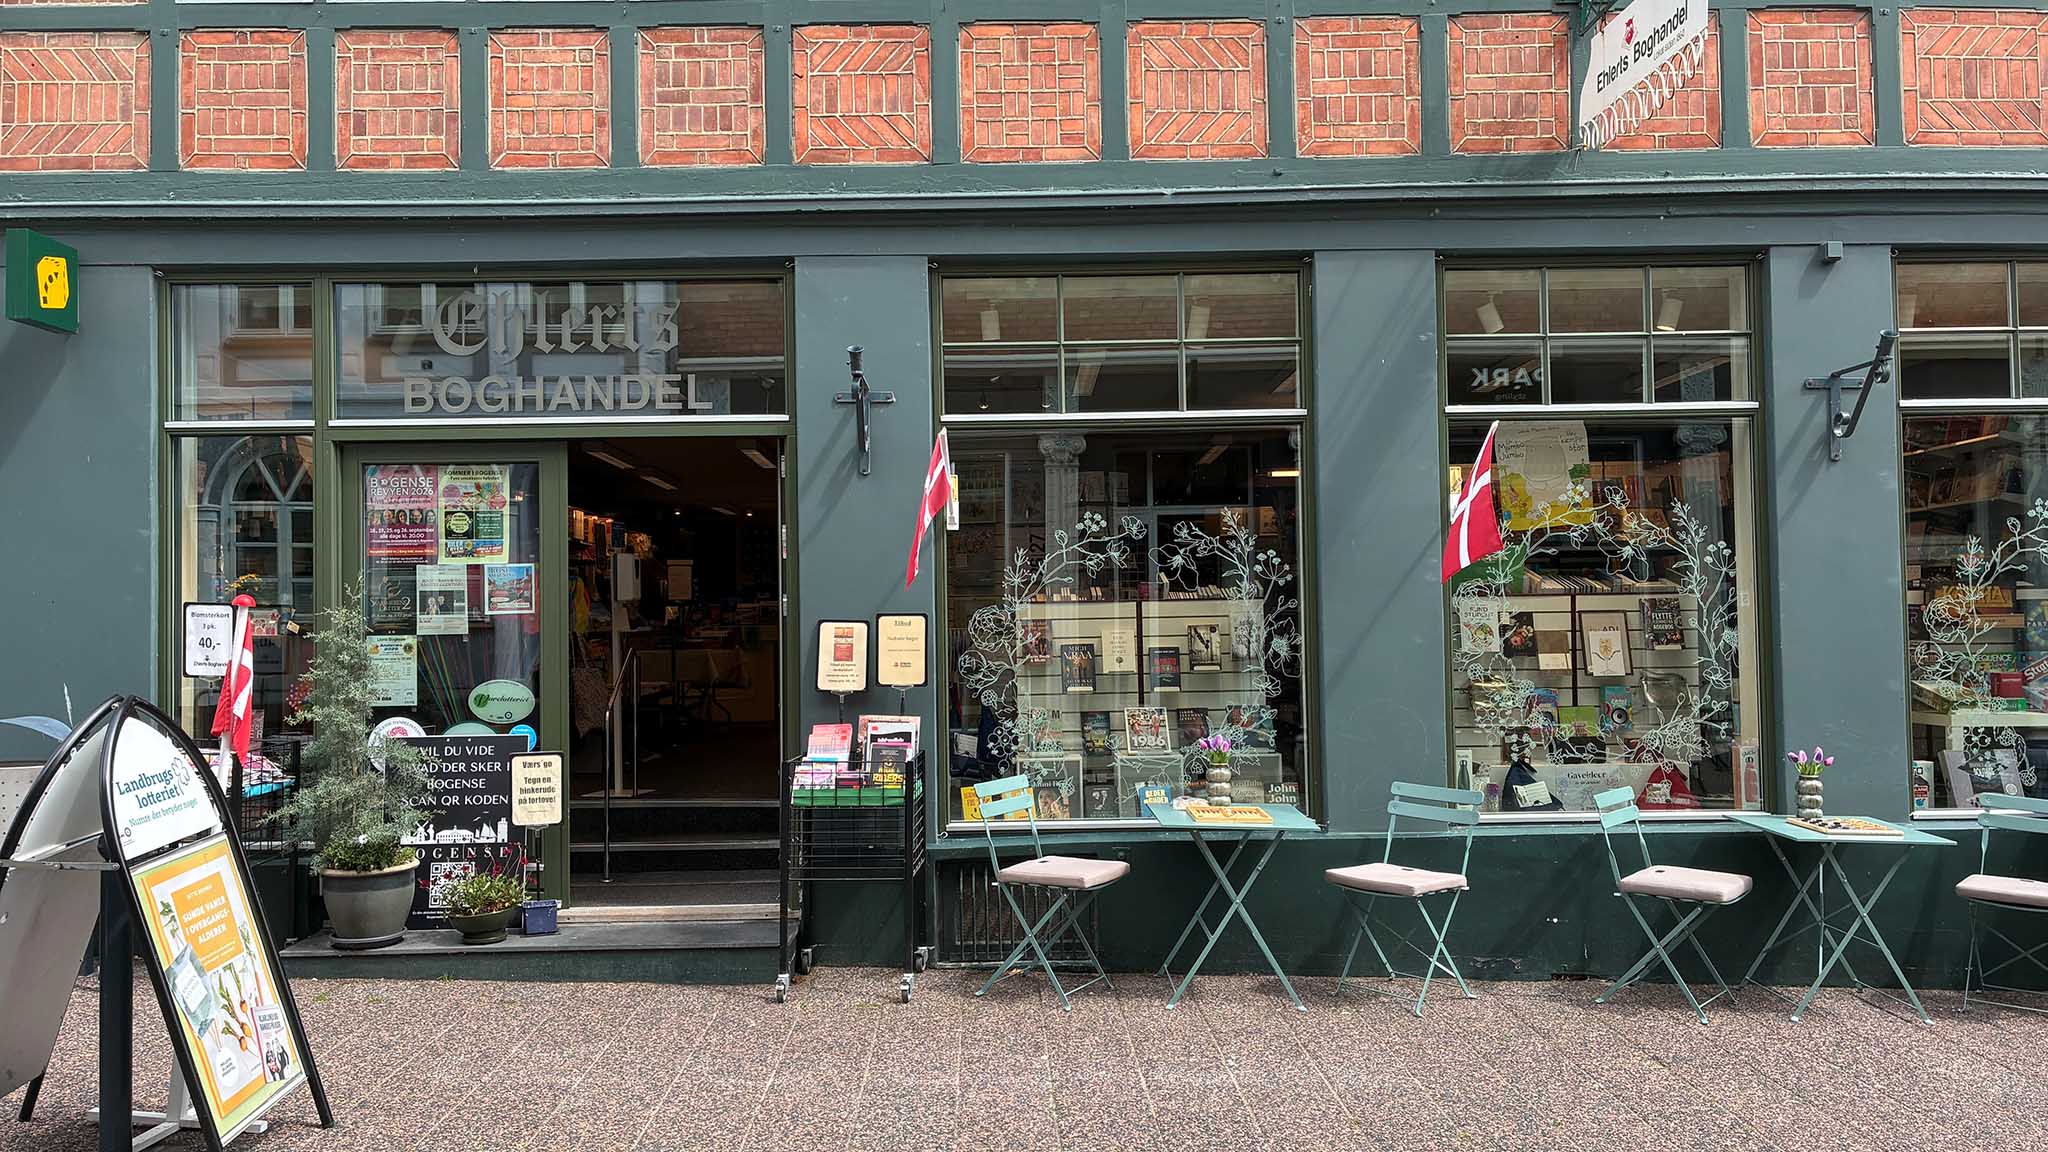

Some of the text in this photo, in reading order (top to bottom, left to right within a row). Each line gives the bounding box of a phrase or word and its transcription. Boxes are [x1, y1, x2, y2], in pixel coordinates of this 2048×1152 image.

[1596, 0, 1688, 93] Ehlerts Boghandel
[433, 288, 681, 365] Ehlerts
[404, 373, 714, 413] BOGHANDEL
[371, 488, 434, 496] REVYEN 2026
[191, 611, 230, 619] Blomsterkort
[198, 637, 221, 650] 40,-
[1132, 735, 1167, 747] 1986
[419, 745, 495, 757] VIL DU VIDE
[442, 762, 467, 773] DER
[471, 761, 502, 772] SKER
[115, 767, 174, 796] Landbrugs
[427, 778, 487, 790] BOGENSE
[1268, 783, 1296, 794] John
[135, 784, 180, 809] lotteriet
[402, 794, 509, 807] SCAN QR KODEN
[1269, 793, 1297, 804] John
[415, 846, 509, 859] OGENSE
